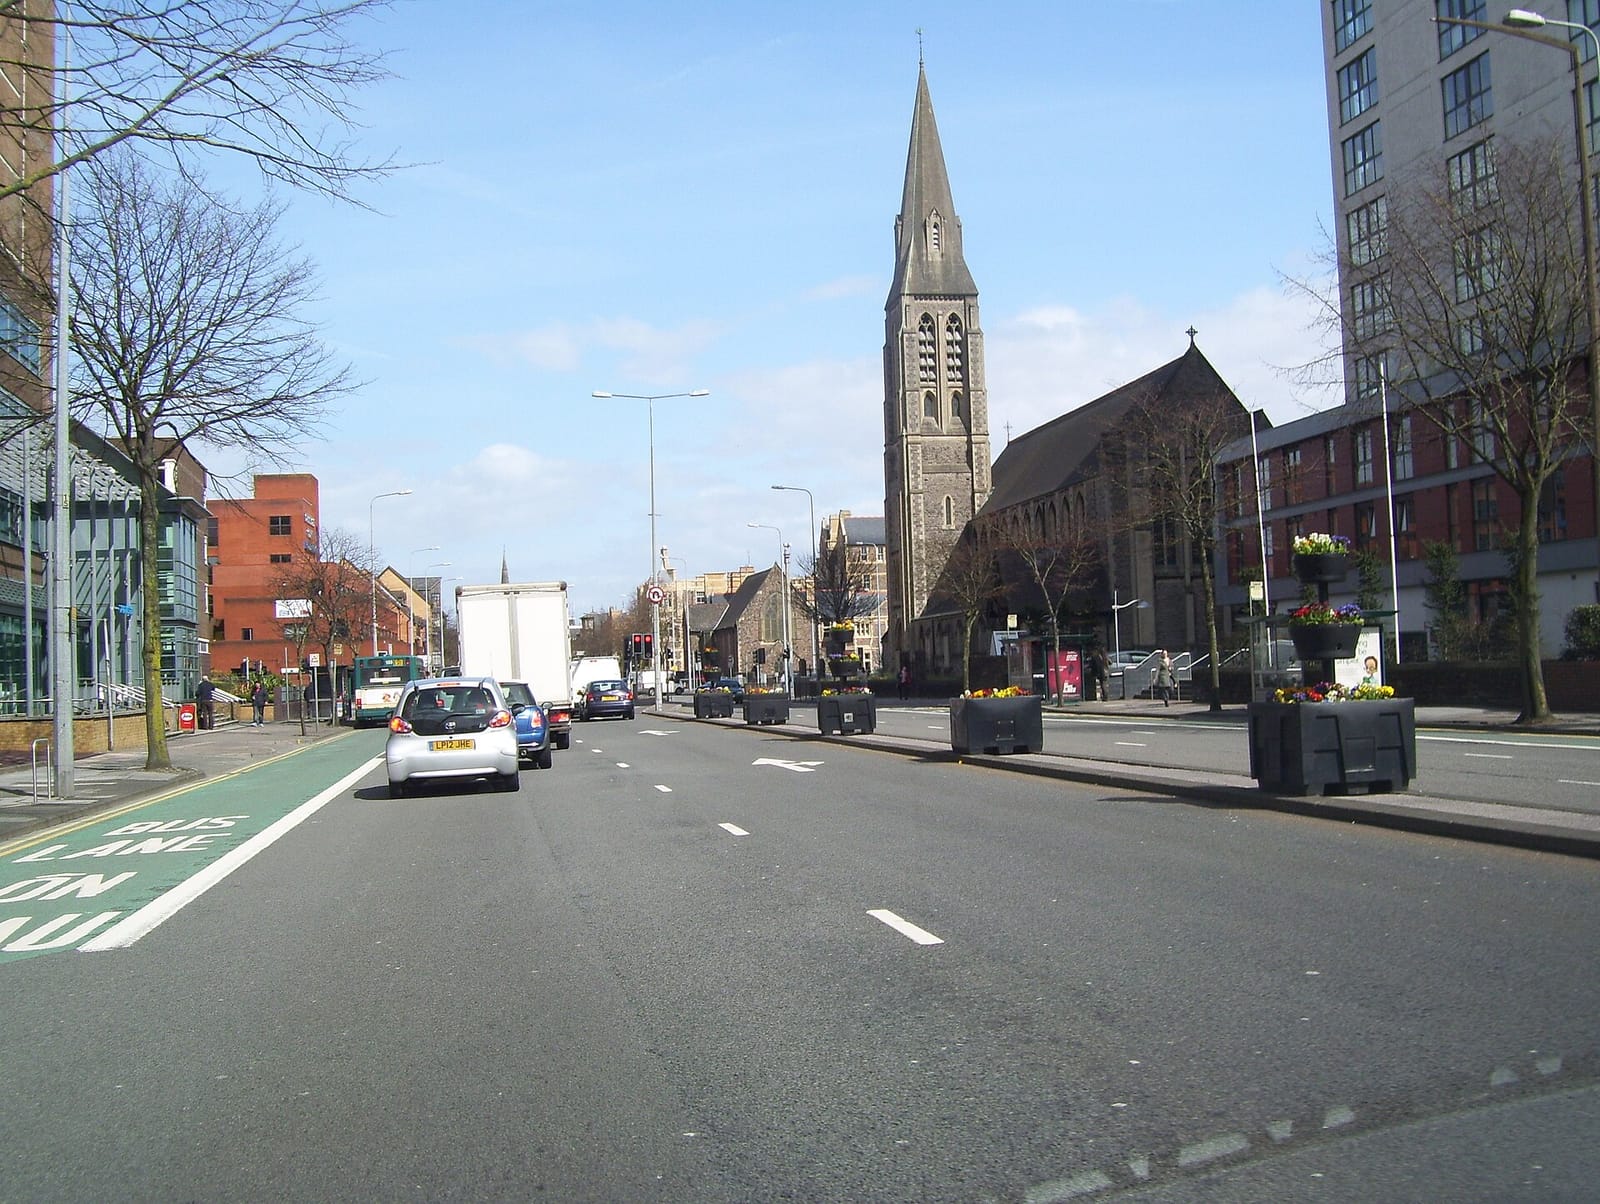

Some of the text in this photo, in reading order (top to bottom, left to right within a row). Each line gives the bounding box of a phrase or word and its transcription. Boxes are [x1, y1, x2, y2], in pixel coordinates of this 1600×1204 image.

[436, 739, 471, 750] LP12 JHE
[103, 815, 250, 836] BUS
[12, 832, 232, 863] LANE
